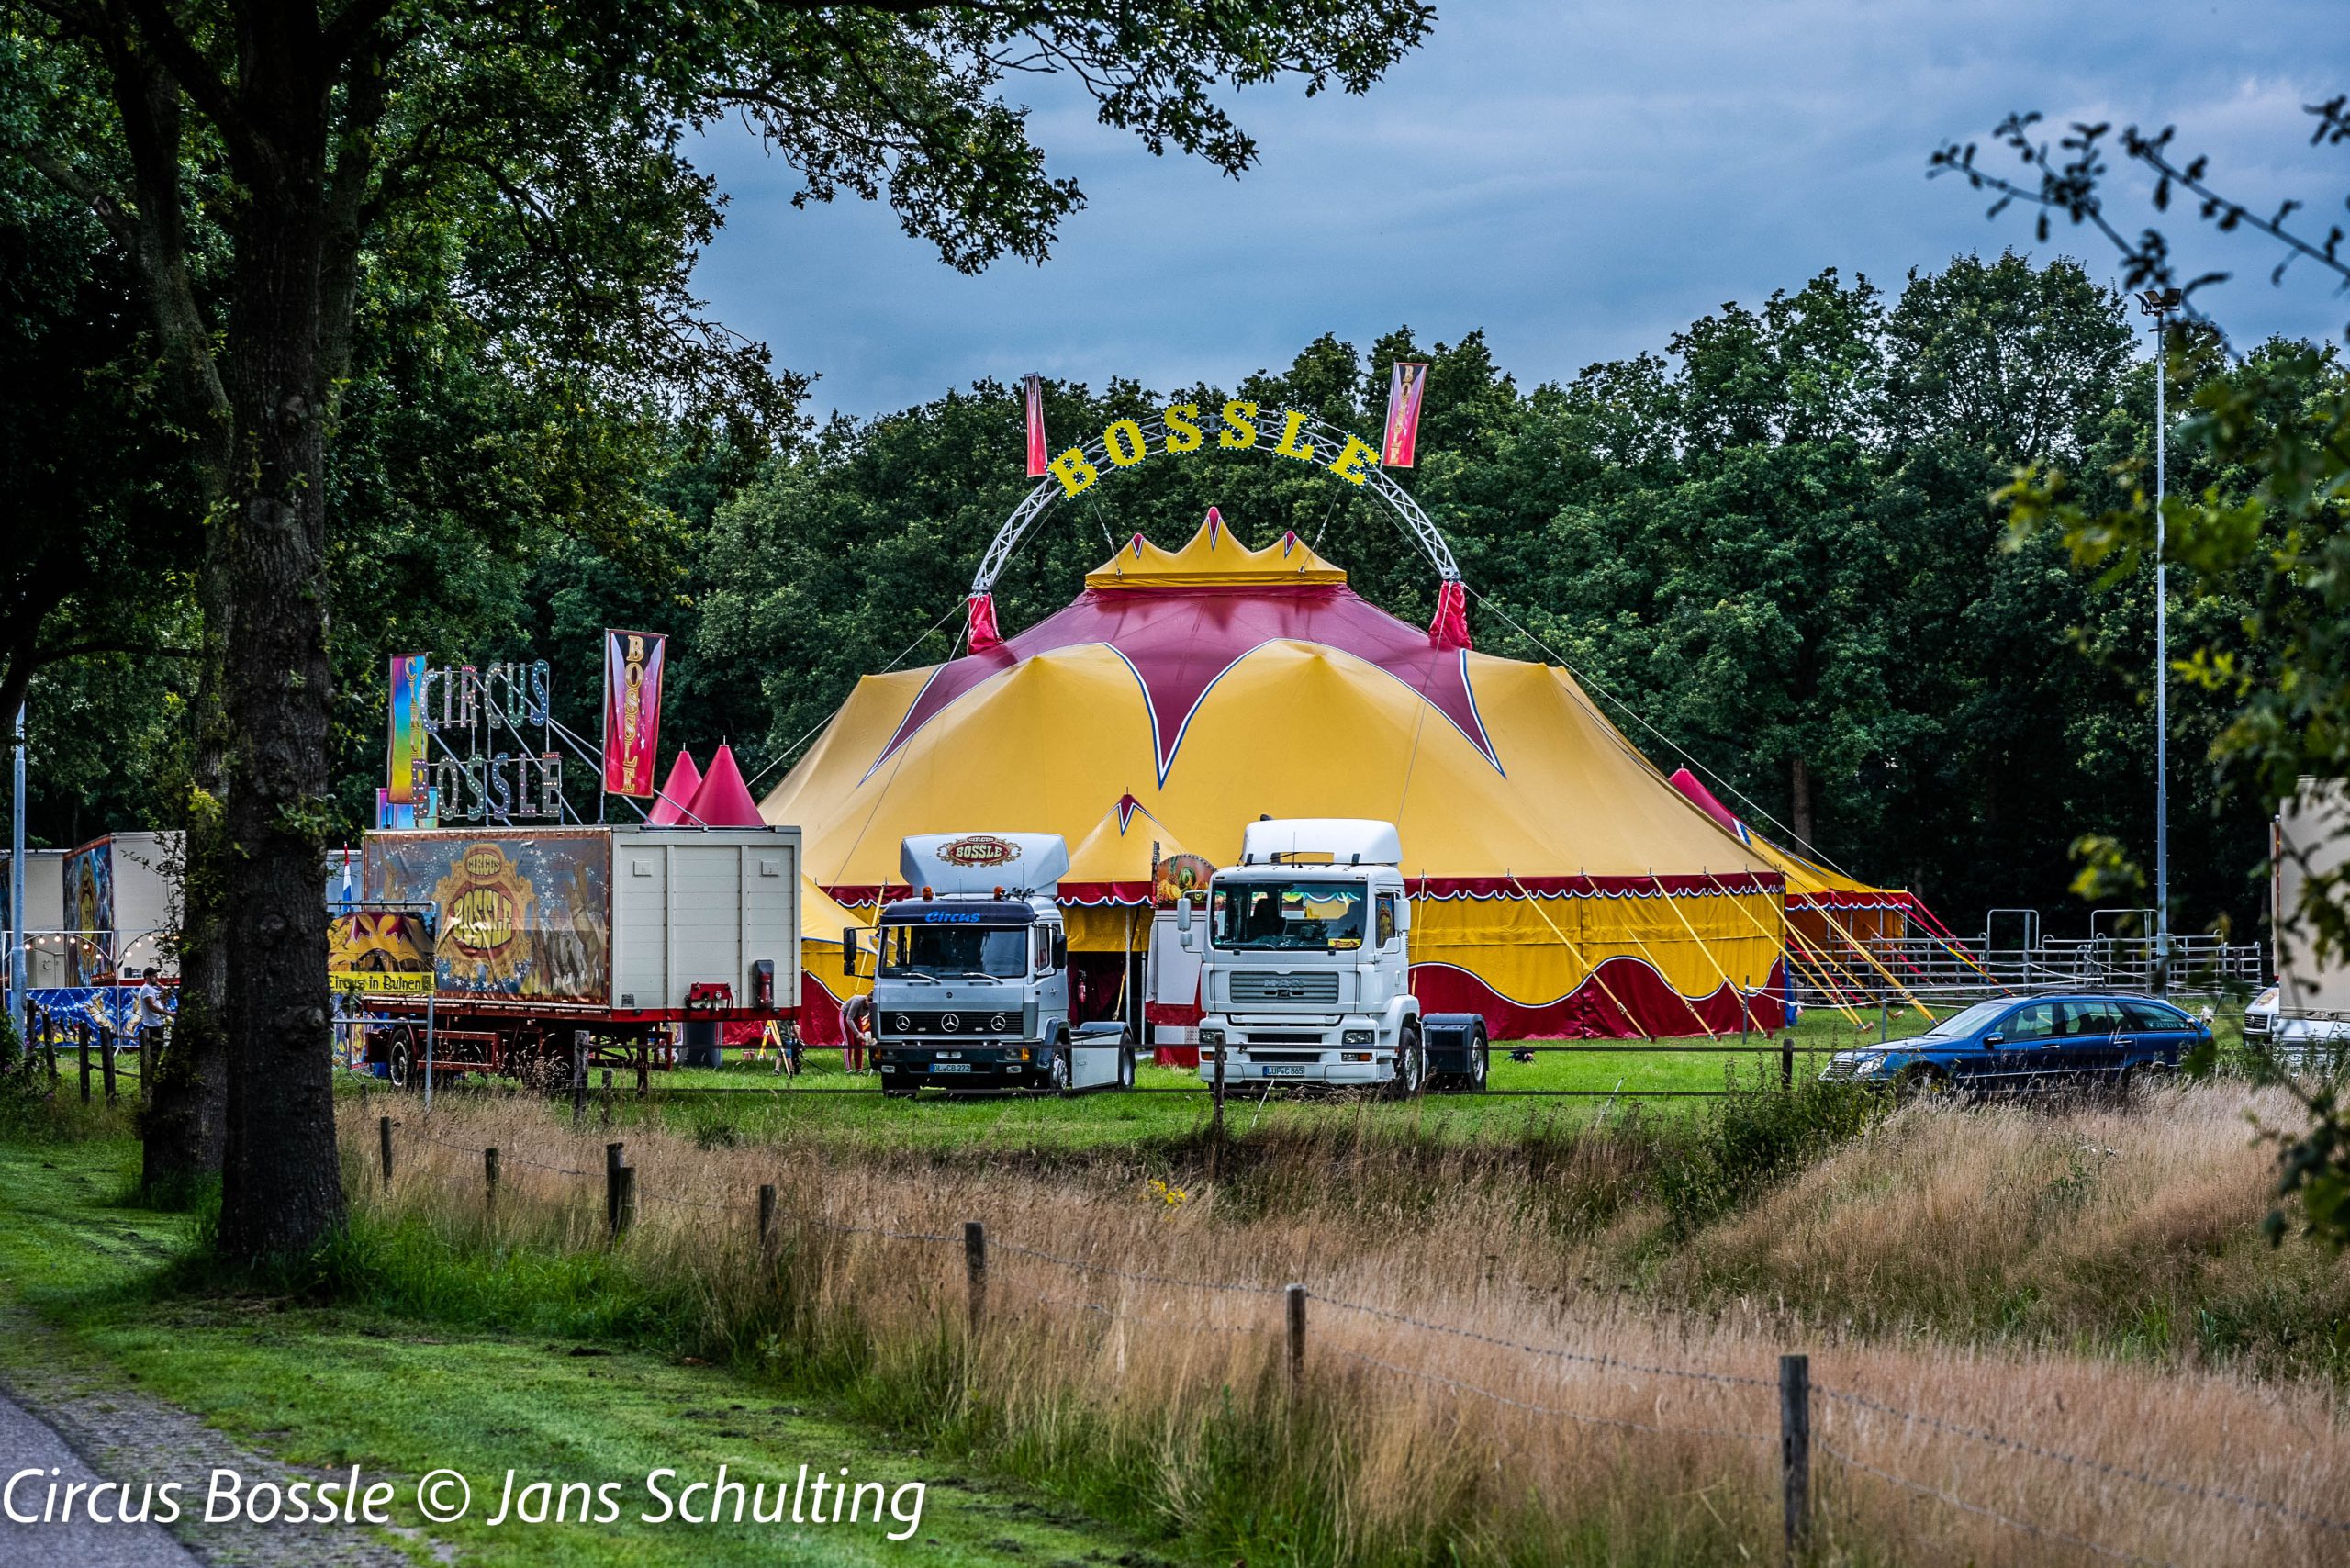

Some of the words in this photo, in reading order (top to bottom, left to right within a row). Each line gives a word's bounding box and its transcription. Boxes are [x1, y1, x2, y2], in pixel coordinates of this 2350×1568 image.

[1047, 398, 1381, 499] BOSSLE
[419, 659, 549, 734] CIRCUS
[621, 635, 645, 794] BOSSLE
[412, 752, 560, 821] BOSSLE
[956, 845, 1002, 859] BOSSLE
[467, 853, 500, 875] CIRCUS
[925, 911, 981, 923] Circus
[369, 976, 378, 989] in
[1263, 979, 1304, 987] MAN
